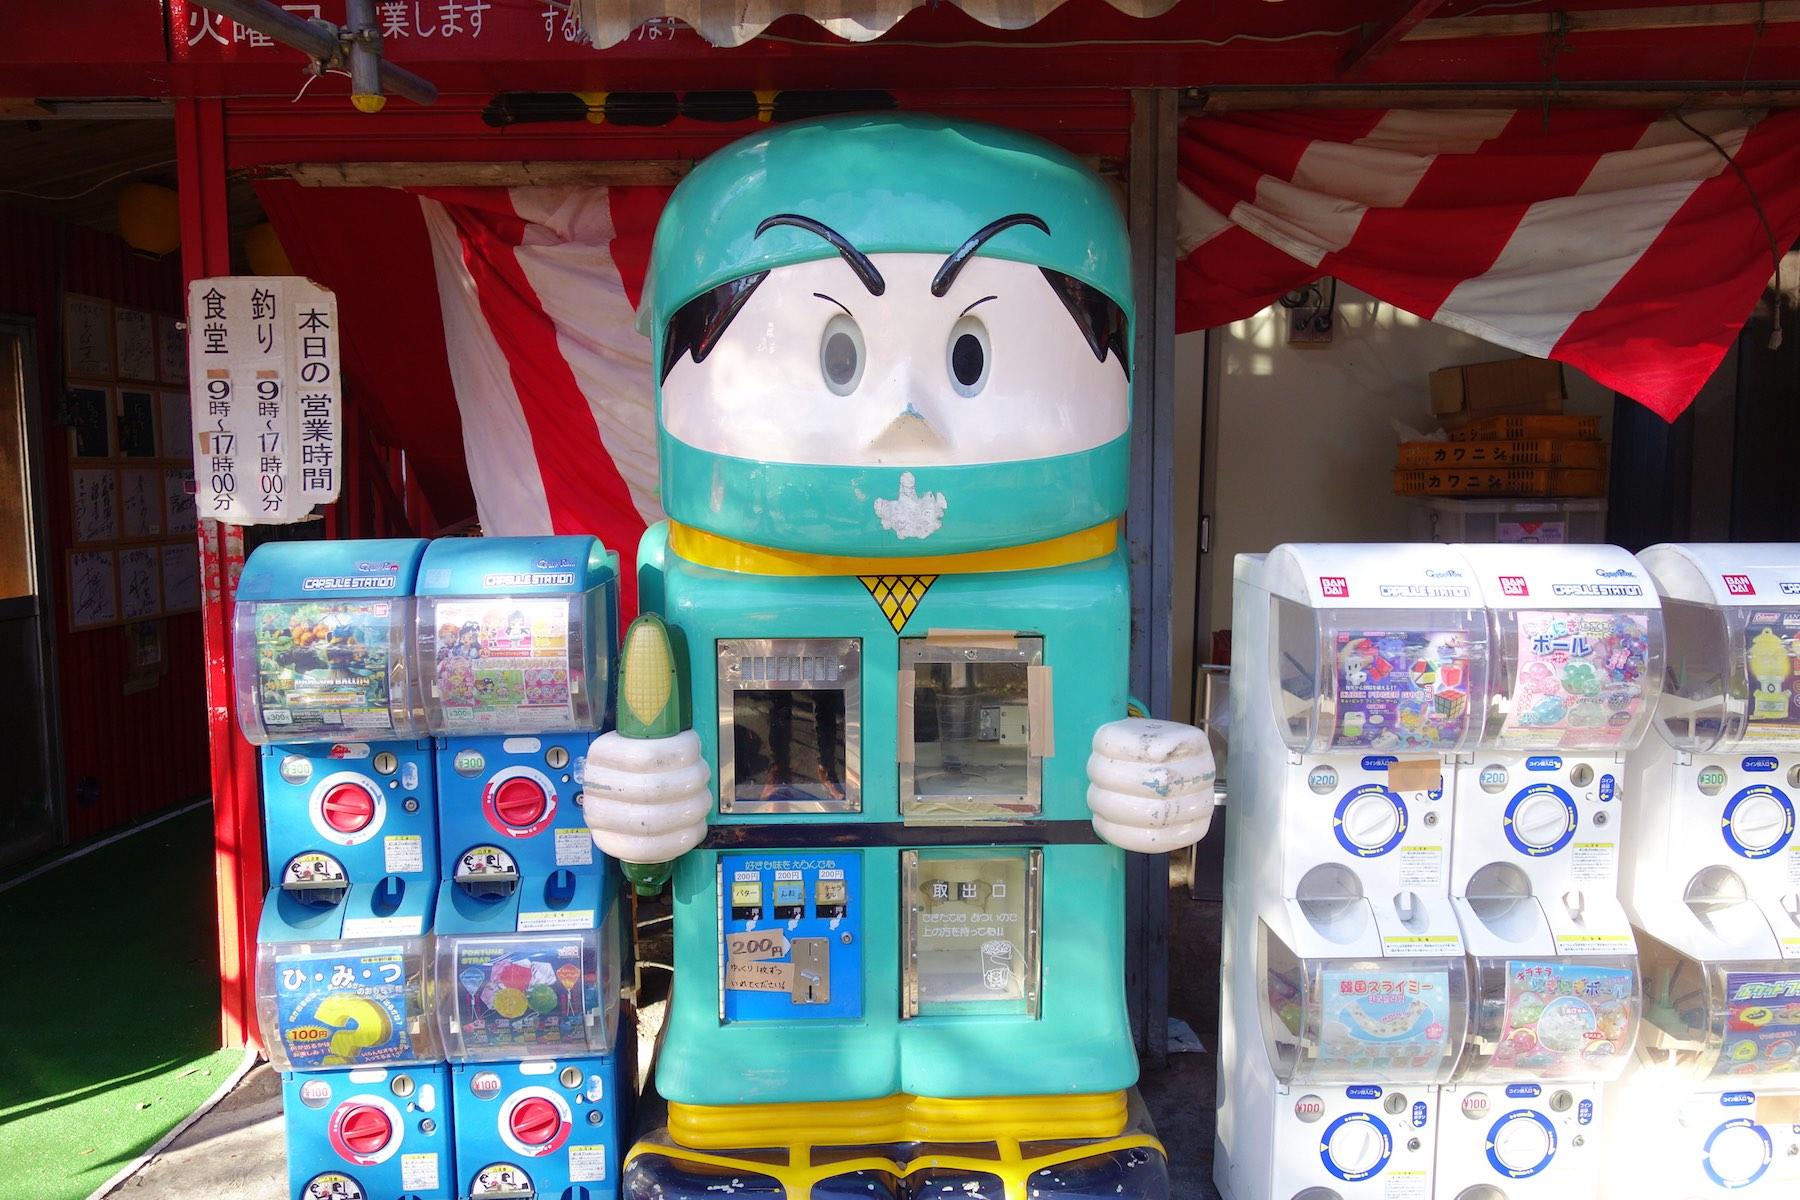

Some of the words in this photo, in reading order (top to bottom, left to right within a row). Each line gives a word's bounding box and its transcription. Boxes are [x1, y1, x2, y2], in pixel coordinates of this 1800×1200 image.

[376, 2, 490, 39] 業します
[202, 287, 229, 354] 食堂
[251, 288, 276, 354] 釣り
[298, 308, 333, 492] 本日の営業時間
[1434, 447, 1507, 462] カワニシ
[1429, 474, 1503, 489] カワニシ
[305, 577, 350, 588] CAPSULE
[351, 576, 394, 587] STATION
[485, 575, 531, 585] CAPSULE
[532, 573, 573, 584] STATION
[1322, 577, 1345, 587] BAN
[1502, 577, 1525, 586] BAN
[1725, 576, 1749, 585] BAN
[1323, 586, 1344, 595] DAI
[1504, 585, 1526, 595] DAI
[1553, 584, 1599, 596] CAPSULE
[1600, 584, 1643, 595] STATION
[1728, 584, 1750, 593] DAI
[1532, 634, 1590, 654] ボール
[1310, 775, 1335, 785] ¥200
[1480, 773, 1505, 783] ¥200
[777, 872, 799, 880] 200円
[736, 889, 758, 897] バター
[933, 883, 1006, 898] 取出口
[732, 938, 783, 957] 200円
[291, 1029, 328, 1041] 100円
[474, 1080, 498, 1090] ¥100
